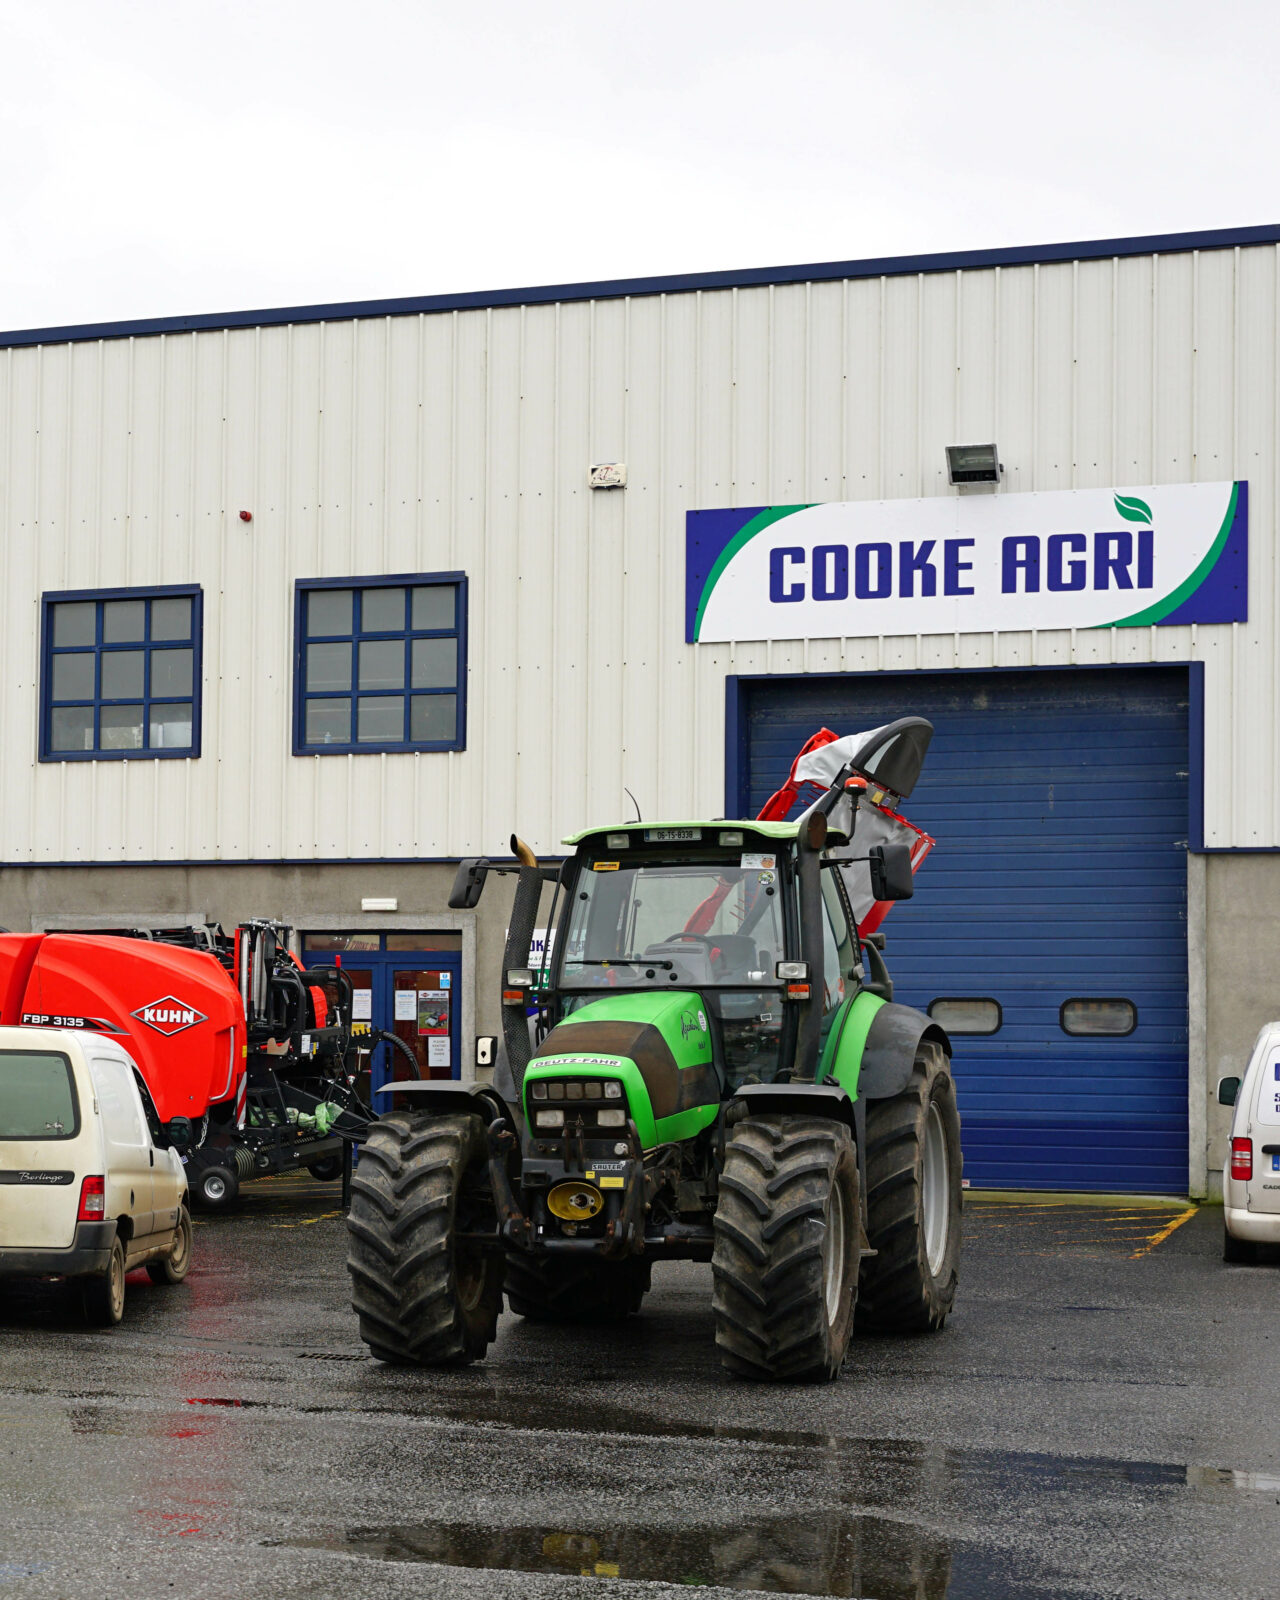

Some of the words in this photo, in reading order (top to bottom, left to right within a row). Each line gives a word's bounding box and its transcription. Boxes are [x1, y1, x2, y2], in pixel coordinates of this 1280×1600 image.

[770, 538, 975, 603] COOKE
[1001, 530, 1154, 594] AGRI
[23, 1014, 49, 1024] FBP
[53, 1016, 84, 1027] 3135
[144, 1008, 195, 1024] KUHN
[535, 1058, 619, 1067] DEUTZ-FAHR
[592, 1163, 623, 1171] SAUTER
[18, 1171, 64, 1183] Berlingo
